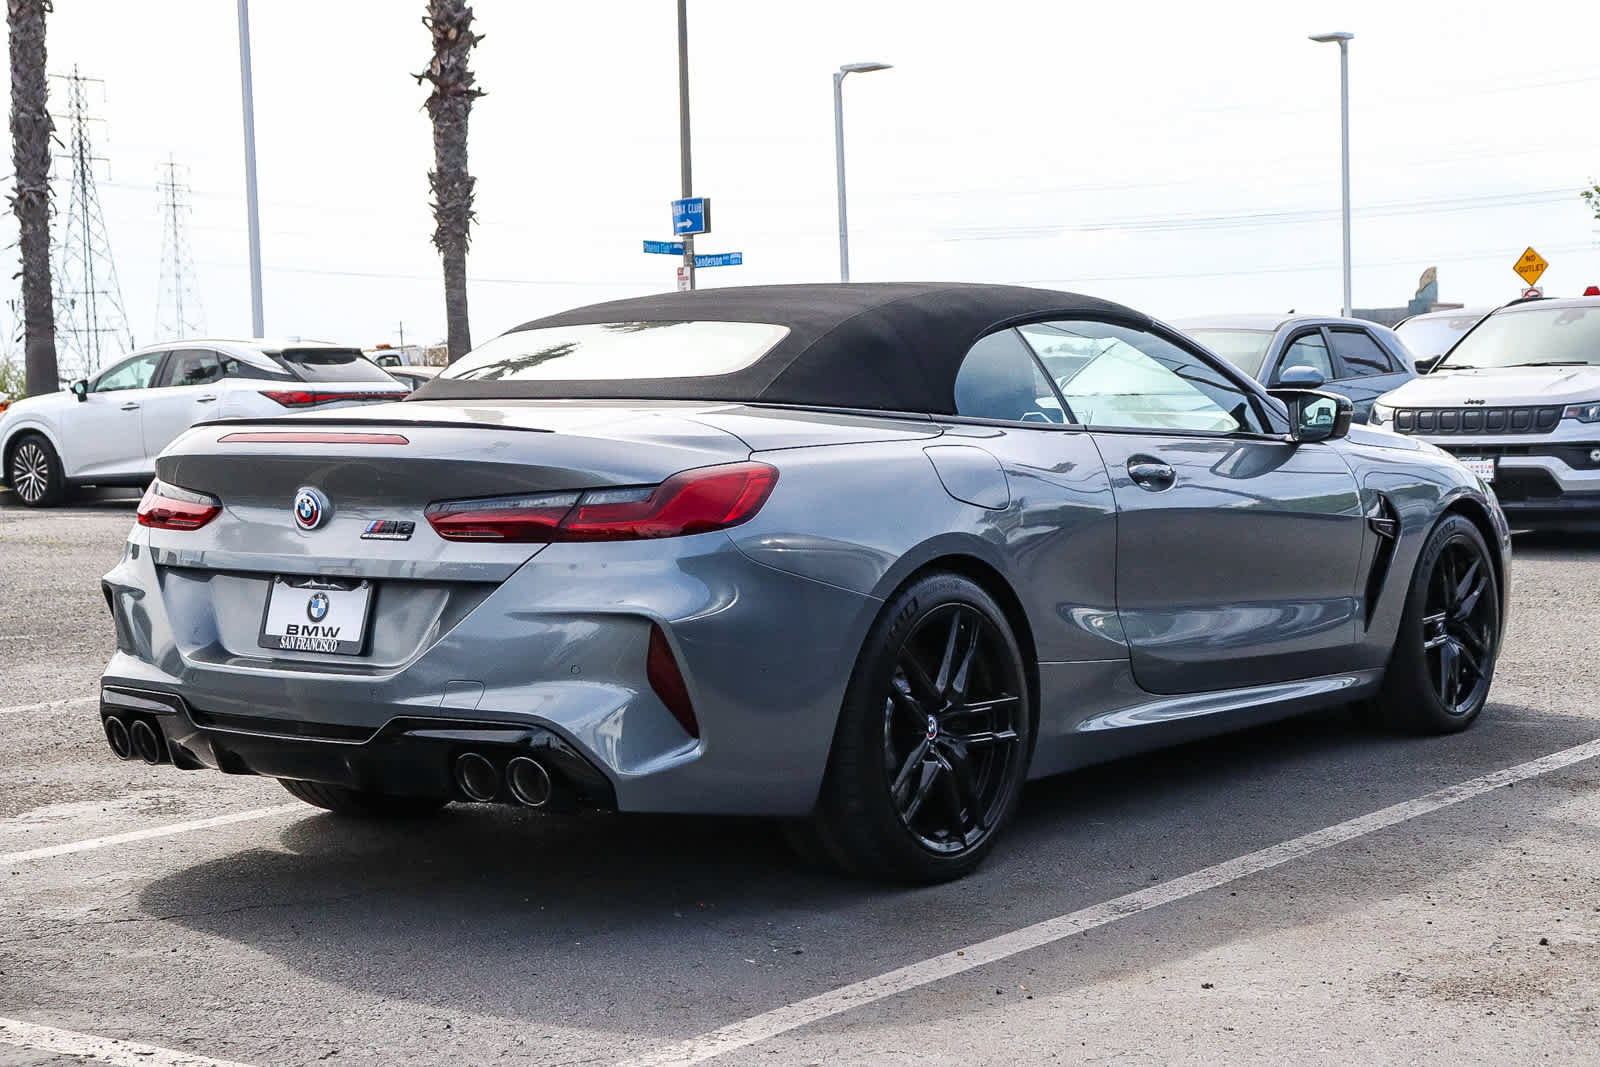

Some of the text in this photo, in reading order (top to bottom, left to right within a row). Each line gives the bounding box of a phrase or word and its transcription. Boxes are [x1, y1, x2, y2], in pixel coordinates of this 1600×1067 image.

[695, 255, 723, 267] Sanderson
[1518, 263, 1544, 272] OUTLET
[286, 624, 341, 638] BMW
[280, 635, 338, 653] SAN FRANCISCO
